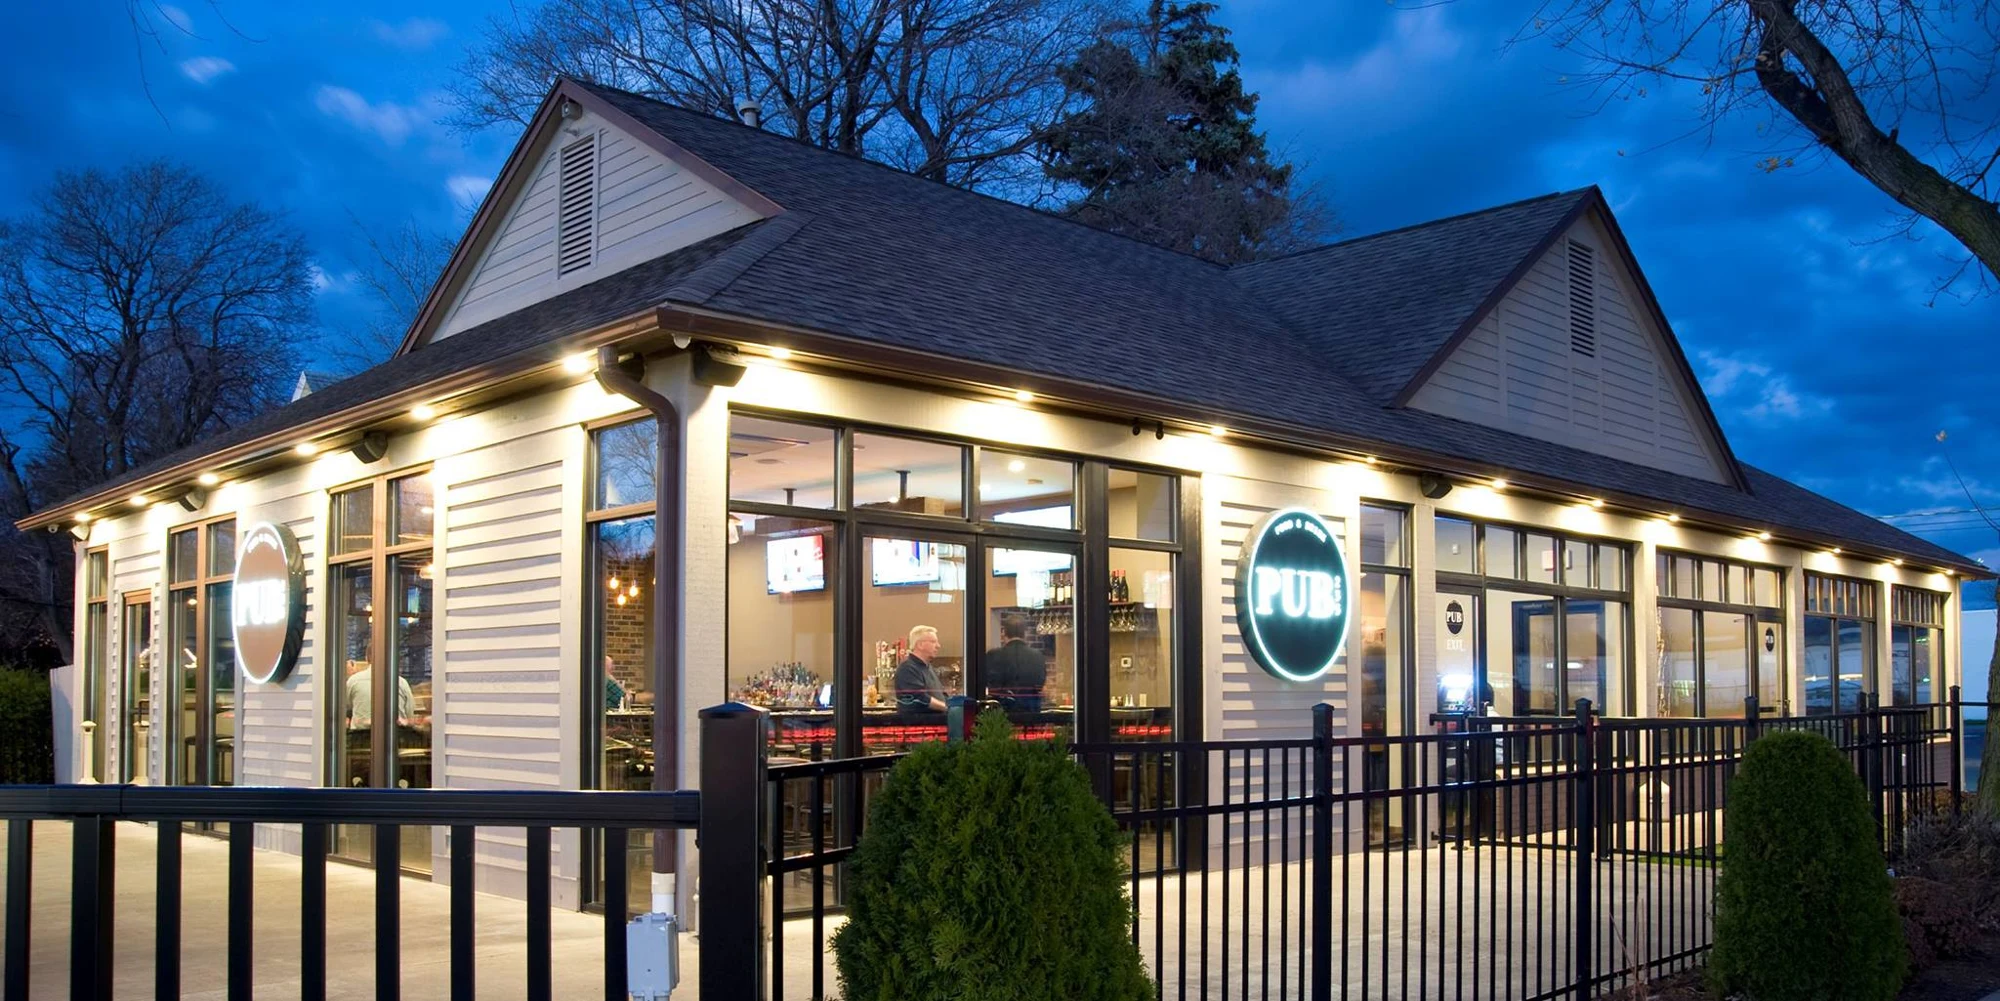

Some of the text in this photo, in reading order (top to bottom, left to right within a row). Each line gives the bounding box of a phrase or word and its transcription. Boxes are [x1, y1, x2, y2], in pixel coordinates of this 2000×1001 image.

[236, 578, 282, 627] PUB
[1255, 566, 1334, 618] PUB
[1446, 611, 1463, 623] PUB
